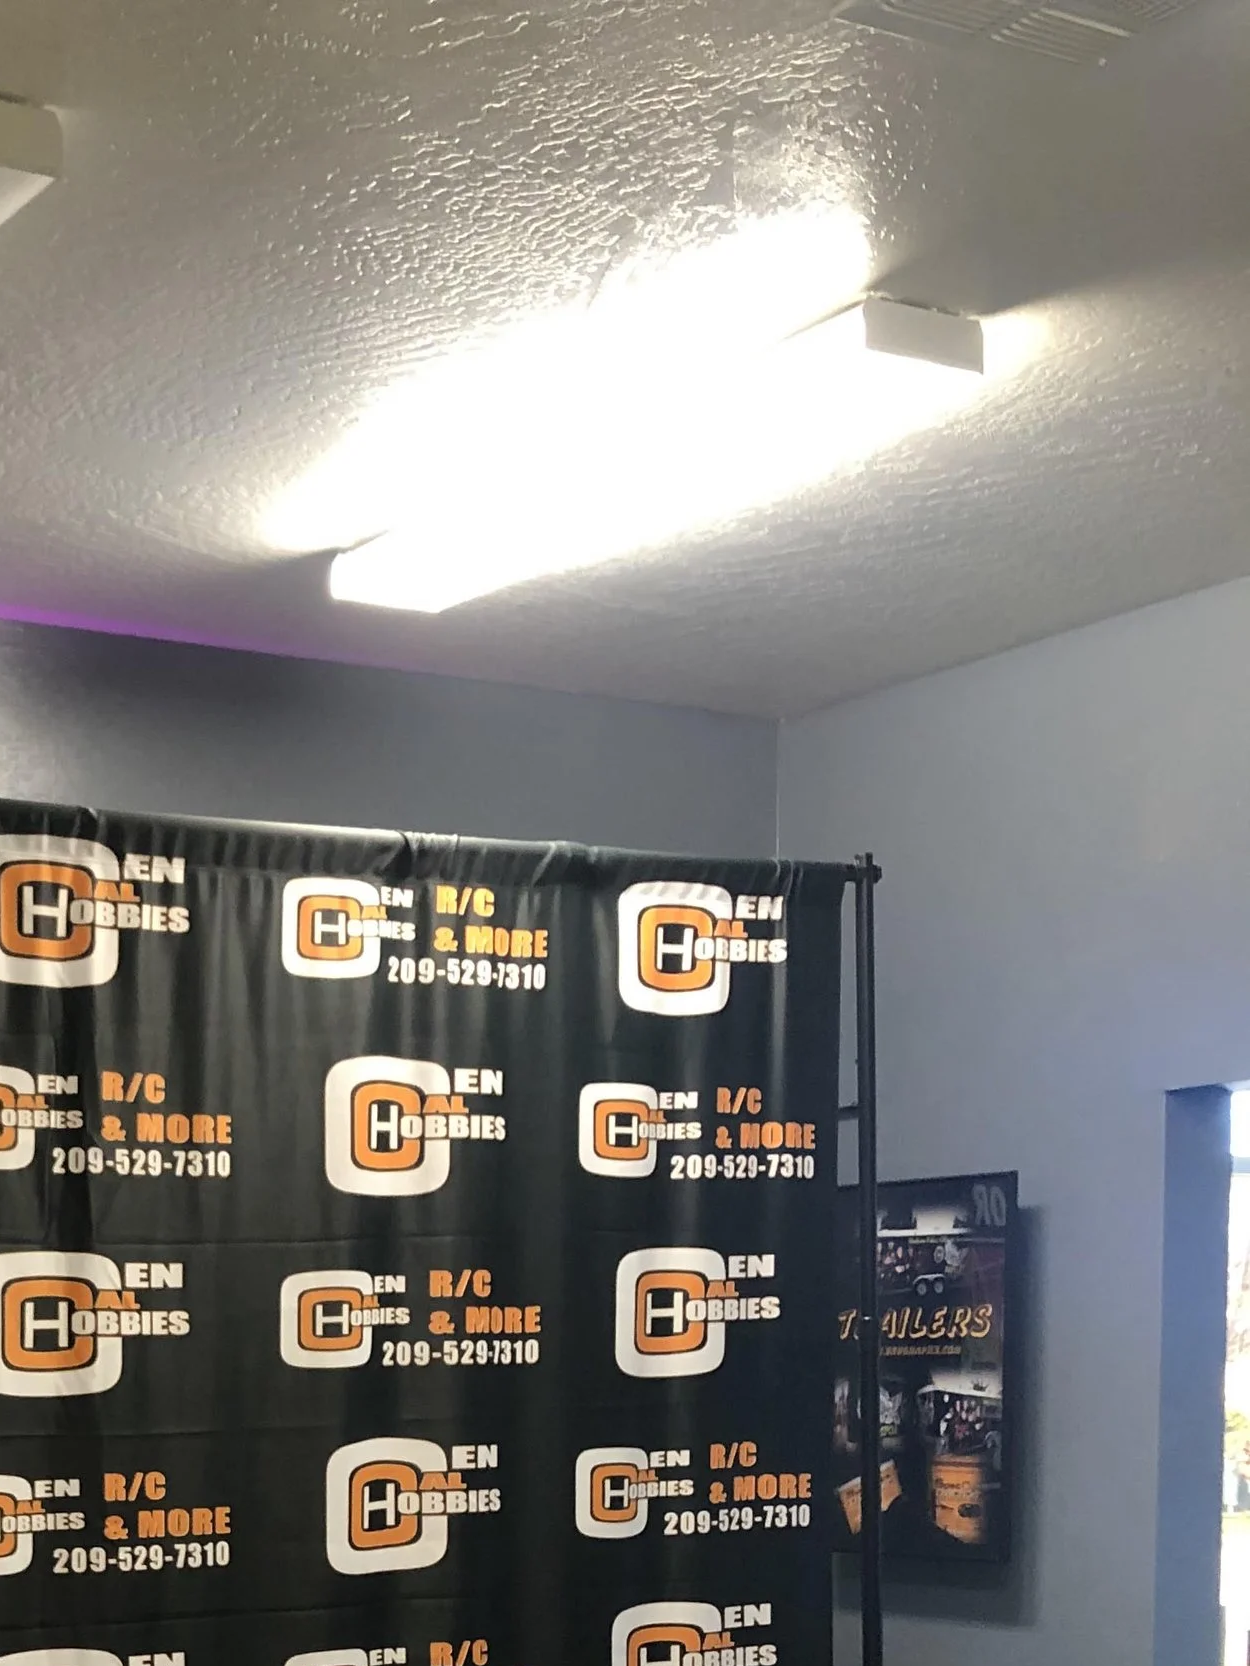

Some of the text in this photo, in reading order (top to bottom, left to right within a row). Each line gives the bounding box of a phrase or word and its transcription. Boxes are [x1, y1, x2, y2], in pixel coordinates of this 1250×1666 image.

[436, 884, 495, 915] R/C
[433, 924, 547, 957] & MORE
[388, 957, 545, 990] 209-529-7310
[100, 1070, 165, 1104] R/C
[717, 1088, 762, 1114] R/C
[101, 1112, 230, 1145] & MORE
[716, 1124, 814, 1149] & MORE
[53, 1147, 230, 1177] 209-529-7310
[670, 1154, 814, 1179] 209-529-7310
[429, 1270, 490, 1297] R/C
[429, 1306, 539, 1334] & MORE
[838, 1303, 993, 1340] TAILERS
[383, 1339, 539, 1366] 209-529-7310
[712, 1443, 754, 1467] R/C
[104, 1472, 164, 1501] R/C
[710, 1475, 809, 1502] & MORE
[104, 1507, 229, 1539] & MORE
[664, 1505, 810, 1535] 209-529-7310
[53, 1541, 229, 1573] 209-529-7310
